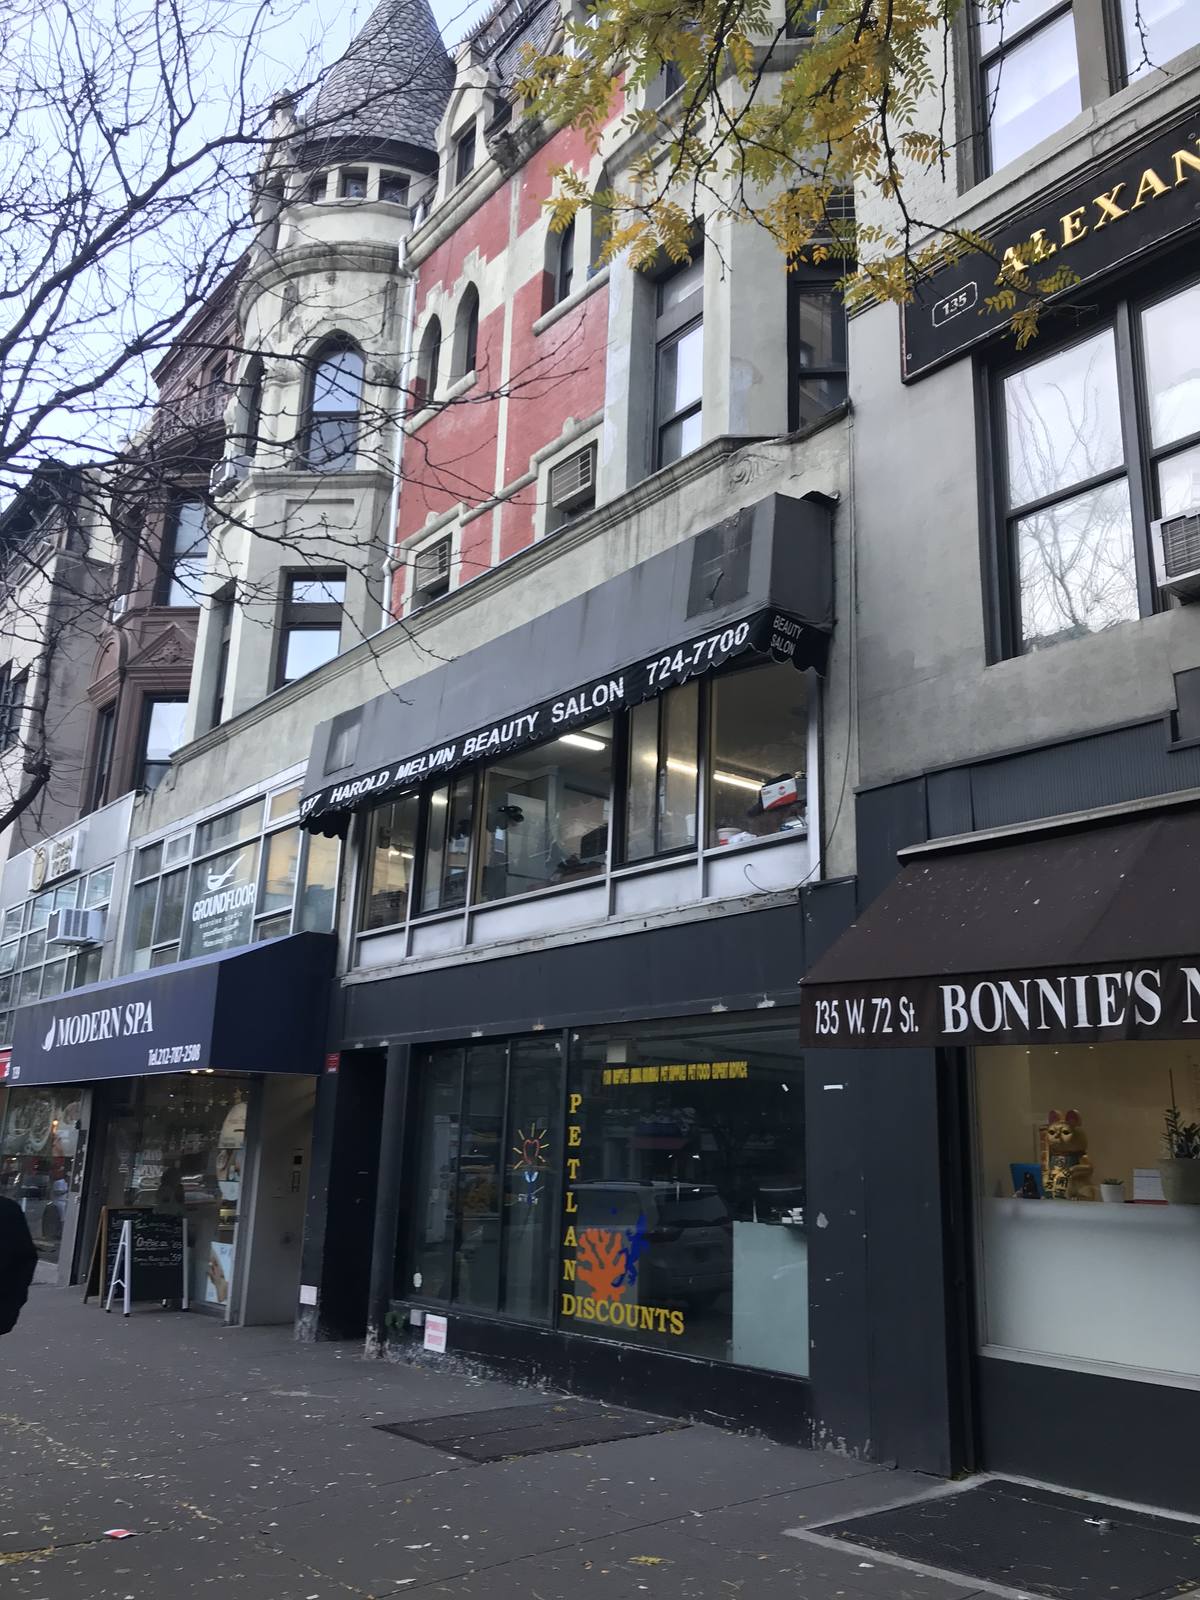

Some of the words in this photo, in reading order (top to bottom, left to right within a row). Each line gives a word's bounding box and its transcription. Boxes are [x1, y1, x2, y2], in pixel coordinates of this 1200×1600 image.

[942, 292, 967, 316] 135
[770, 634, 796, 656] SALON
[772, 615, 803, 640] BEAUTY
[300, 793, 323, 816] 137
[329, 771, 390, 803] HAROLD
[395, 745, 456, 780] MELVIN
[462, 711, 540, 757] BEAUTY
[551, 677, 624, 723] SALON
[646, 622, 750, 685] 724-7700
[192, 883, 256, 921] GROUNDFLOOR
[815, 1000, 839, 1035] 135
[845, 998, 866, 1035] W.
[871, 998, 893, 1033] 72
[900, 996, 919, 1034] St.
[938, 968, 1162, 1034] BONNIE'S
[56, 1006, 123, 1047] MODERN
[124, 1000, 153, 1036] SPA
[561, 1293, 685, 1336] DISCOUNTS
